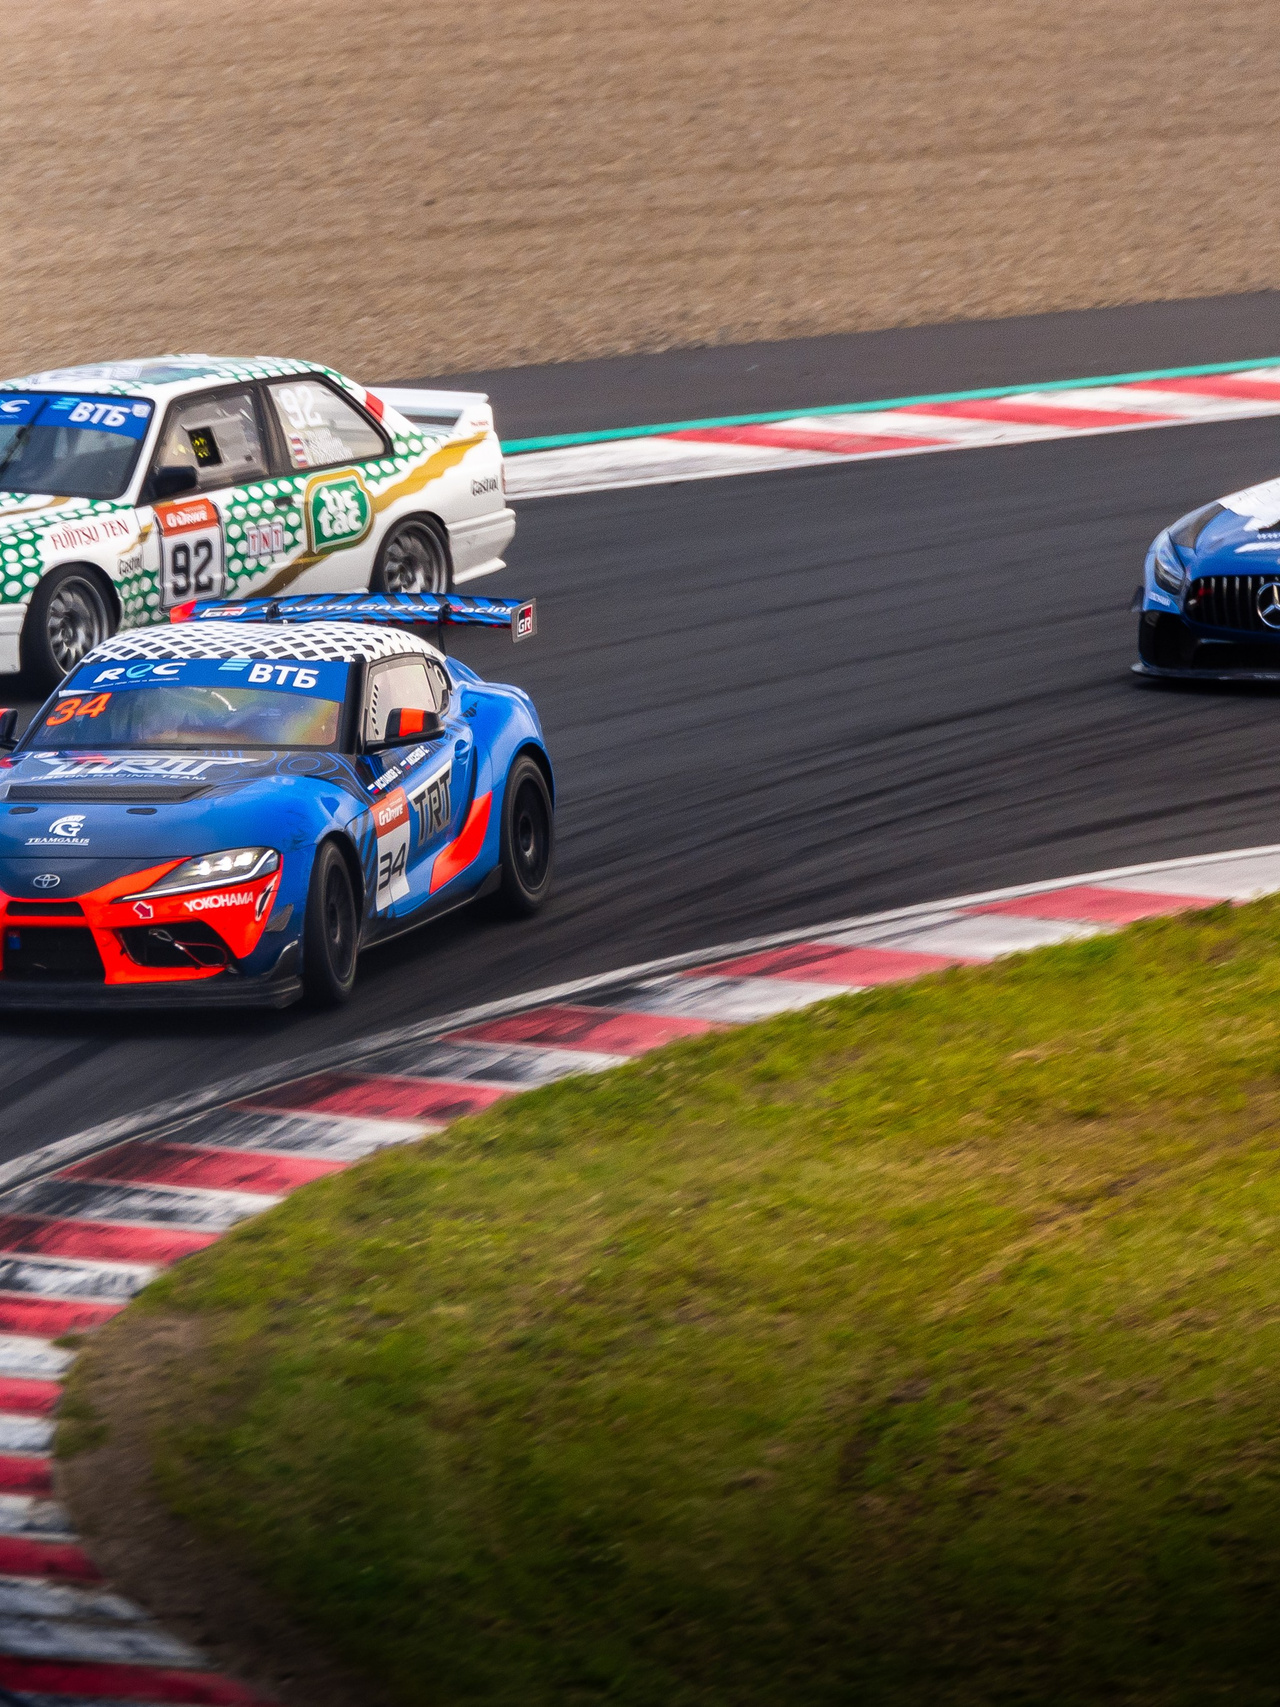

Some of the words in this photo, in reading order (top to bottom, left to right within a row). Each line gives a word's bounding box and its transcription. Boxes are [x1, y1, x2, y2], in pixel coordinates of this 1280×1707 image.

[278, 386, 323, 430] 92
[50, 523, 100, 550] FUJITSU
[102, 519, 129, 538] TEN
[171, 538, 214, 598] 92
[46, 692, 113, 726] 34
[162, 773, 207, 781] TEAM
[411, 766, 452, 845] TRT
[379, 842, 406, 891] 34
[184, 892, 254, 912] YOKOHAMA
